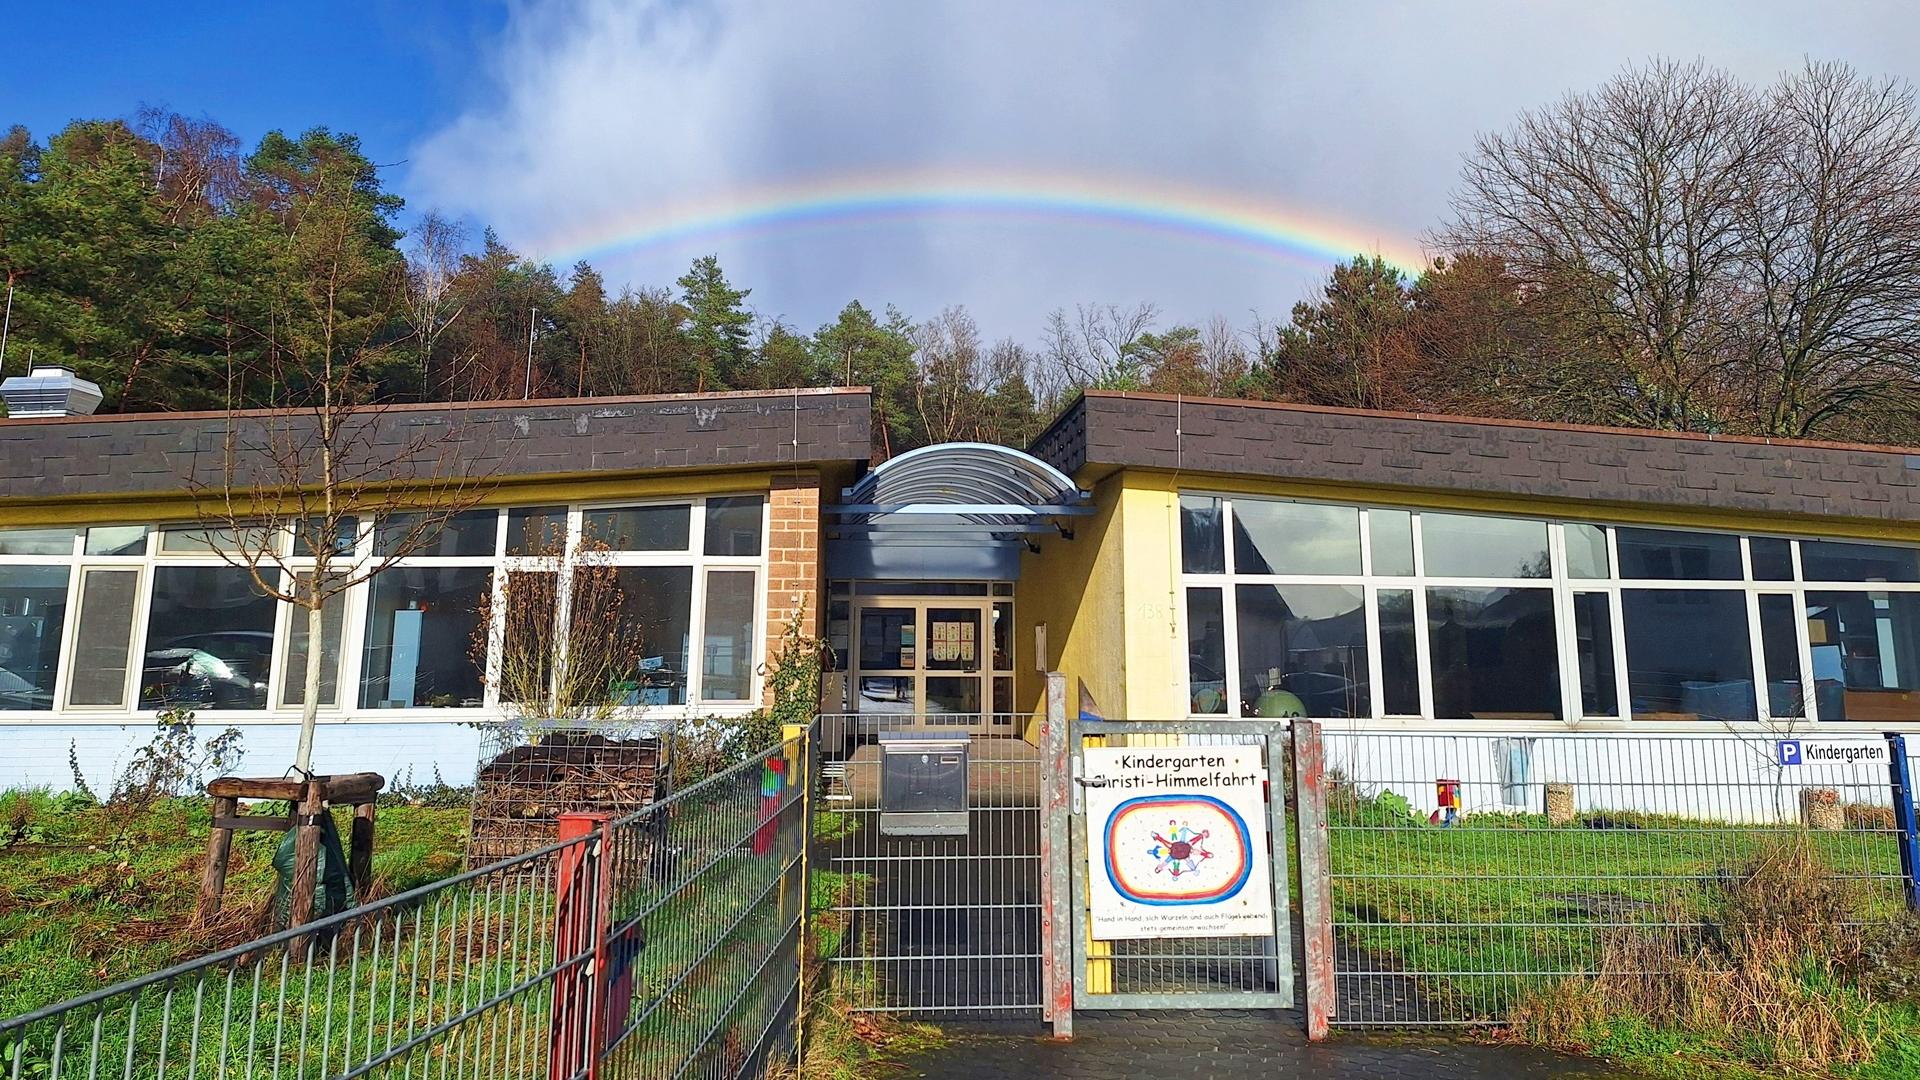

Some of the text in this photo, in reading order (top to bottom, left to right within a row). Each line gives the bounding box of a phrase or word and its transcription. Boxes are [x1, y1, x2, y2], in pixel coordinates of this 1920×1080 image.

[1783, 744, 1884, 763] P Kindergarten
[1122, 754, 1225, 772] Kindergarten
[1160, 925, 1194, 933] gemeinsam
